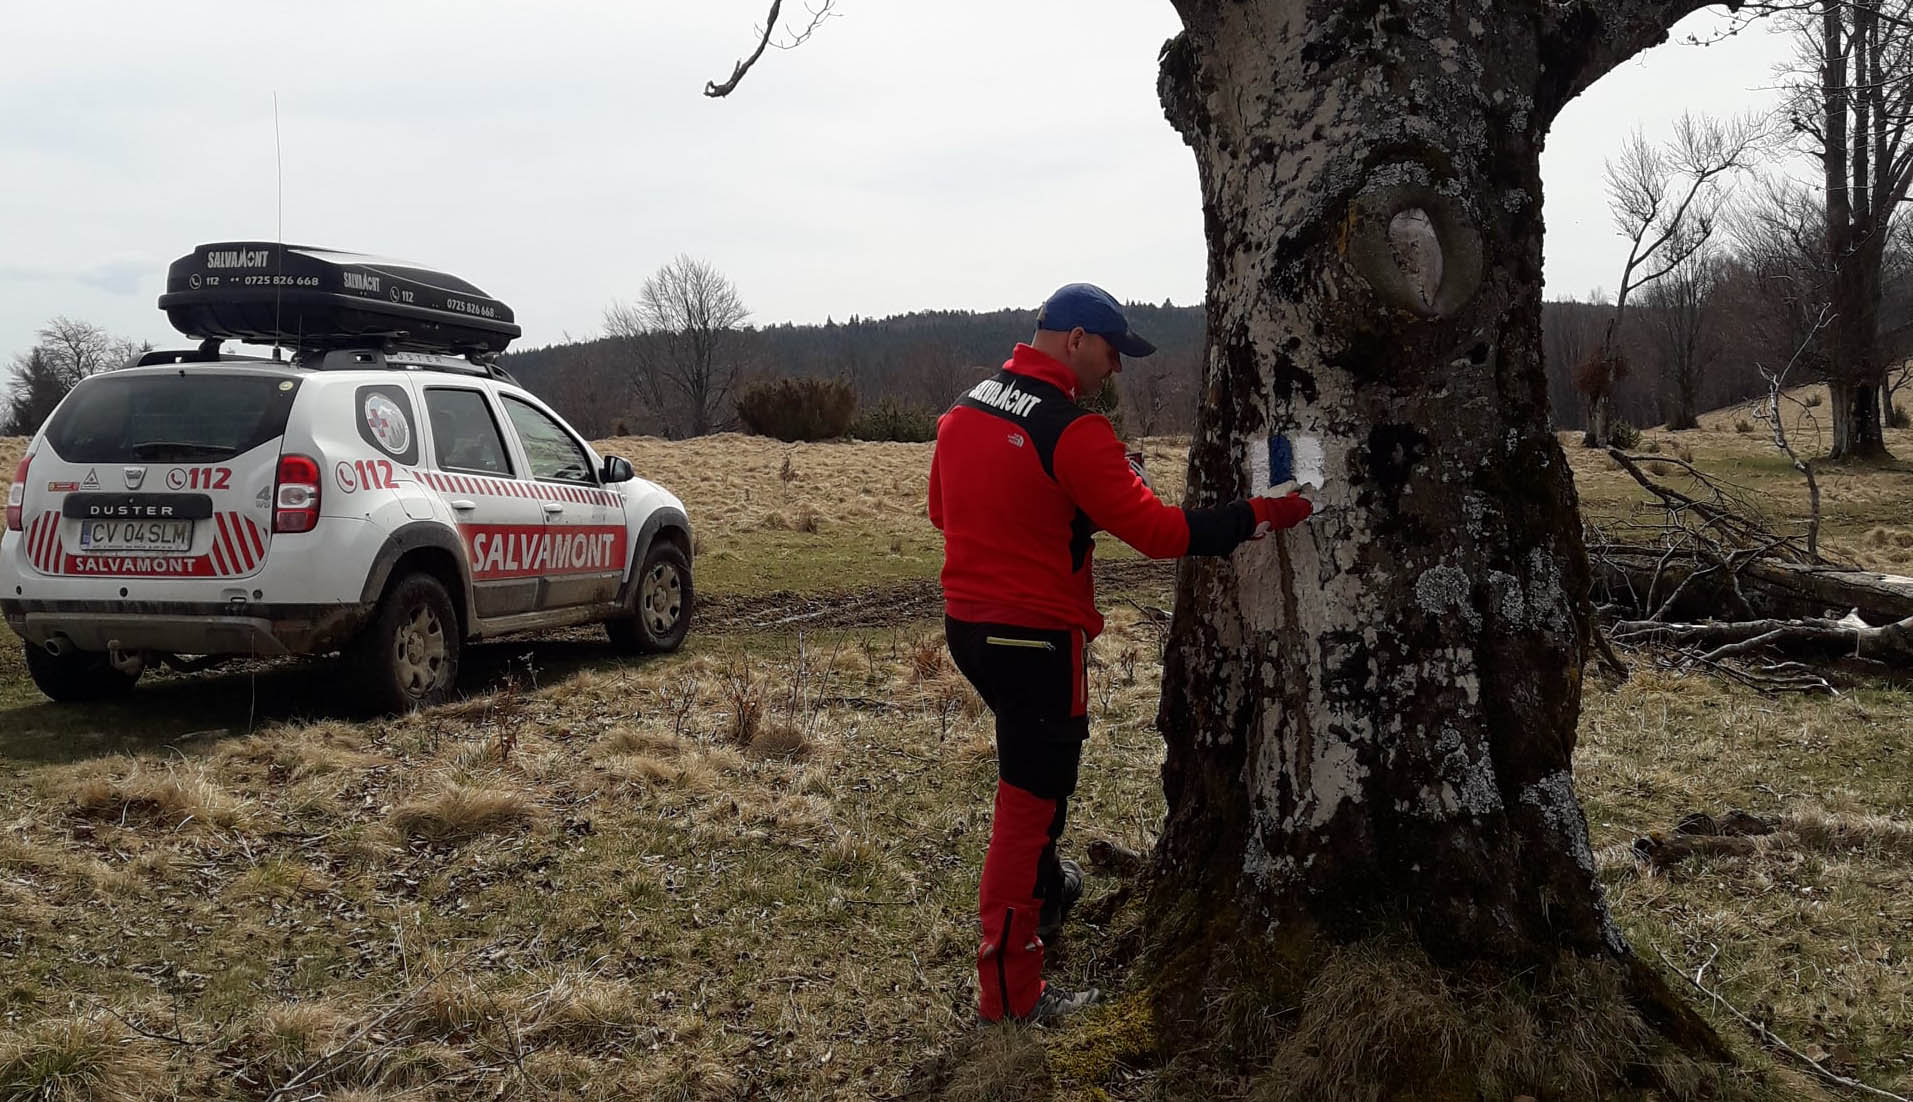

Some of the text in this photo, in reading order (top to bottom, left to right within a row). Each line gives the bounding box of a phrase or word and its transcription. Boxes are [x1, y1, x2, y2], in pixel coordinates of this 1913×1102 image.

[207, 247, 269, 269] SALVAMONT
[206, 276, 319, 286] 112 0725 826 668
[343, 271, 380, 293] SALVAMONT
[401, 290, 495, 318] 112 0725 826 668
[188, 467, 233, 490] 112
[354, 459, 400, 491] 112
[255, 485, 271, 501] 4
[90, 505, 174, 516] DUSTER
[92, 523, 118, 543] CV
[124, 523, 144, 543] 04
[148, 523, 186, 544] SLM
[472, 533, 615, 573] SALVAMONT
[76, 557, 197, 573] SALVAMONT
